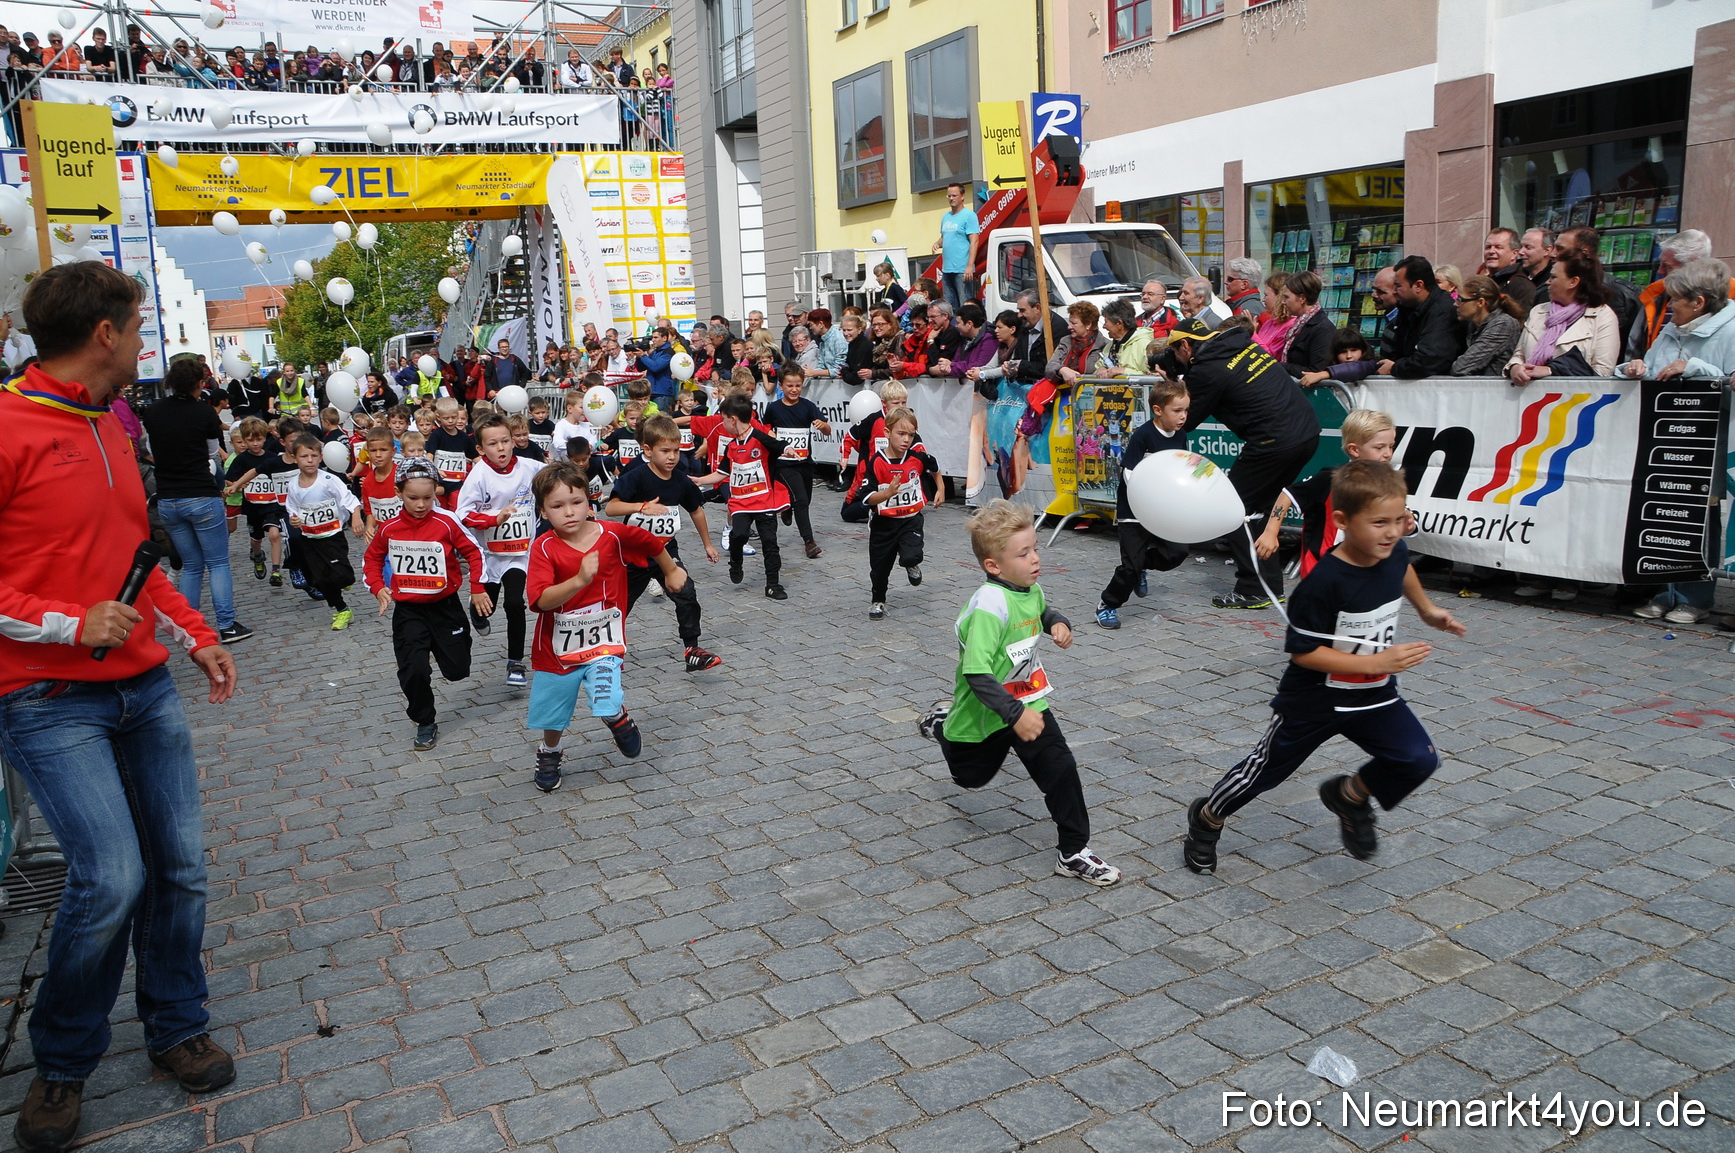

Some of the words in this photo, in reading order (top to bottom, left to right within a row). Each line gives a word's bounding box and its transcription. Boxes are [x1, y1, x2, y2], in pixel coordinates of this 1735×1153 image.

[311, 9, 366, 22] WERDEN!
[314, 23, 366, 32] www.dkms.de
[230, 109, 310, 128] aufsport
[444, 111, 493, 126] BMW
[497, 110, 579, 129] Laufsport
[996, 141, 1016, 155] lauf
[56, 158, 94, 178] lauf
[1086, 167, 1109, 180] Unterer
[1108, 164, 1127, 175] Markt
[1128, 160, 1136, 172] 15
[174, 184, 226, 193] Neumarkter
[228, 184, 268, 194] Stadtlauf
[318, 166, 410, 199] ZIEL
[455, 182, 501, 191] Neumarkter
[501, 180, 536, 190] Stadtlauf
[978, 209, 999, 233] celine.
[1102, 400, 1126, 412] erdgas
[1673, 397, 1701, 406] Strom
[1668, 424, 1697, 434] Erdgas
[622, 446, 640, 457] 726
[1055, 446, 1075, 454] Pflaste
[1198, 435, 1247, 457] Sicher
[1663, 452, 1695, 462] Wasser
[438, 458, 463, 471] 7174
[1058, 467, 1077, 475] Palisa
[732, 470, 760, 486] 7271
[249, 481, 275, 494] 7390
[1659, 480, 1692, 491] Wärme
[885, 488, 918, 508] 7194
[301, 508, 335, 526] 7129
[374, 505, 402, 521] 738
[1655, 507, 1690, 519] Freizeit
[493, 519, 529, 541] 7201
[635, 516, 675, 535] 7133
[1411, 507, 1535, 545] umarkt
[502, 543, 525, 551] Jonas
[1645, 534, 1692, 547] Stadtbusse
[392, 554, 440, 575] 7243
[1642, 561, 1693, 571] Parkhäuser
[578, 614, 611, 627] Neumarkt
[1339, 620, 1375, 630] PARTL
[558, 620, 614, 652] 7131
